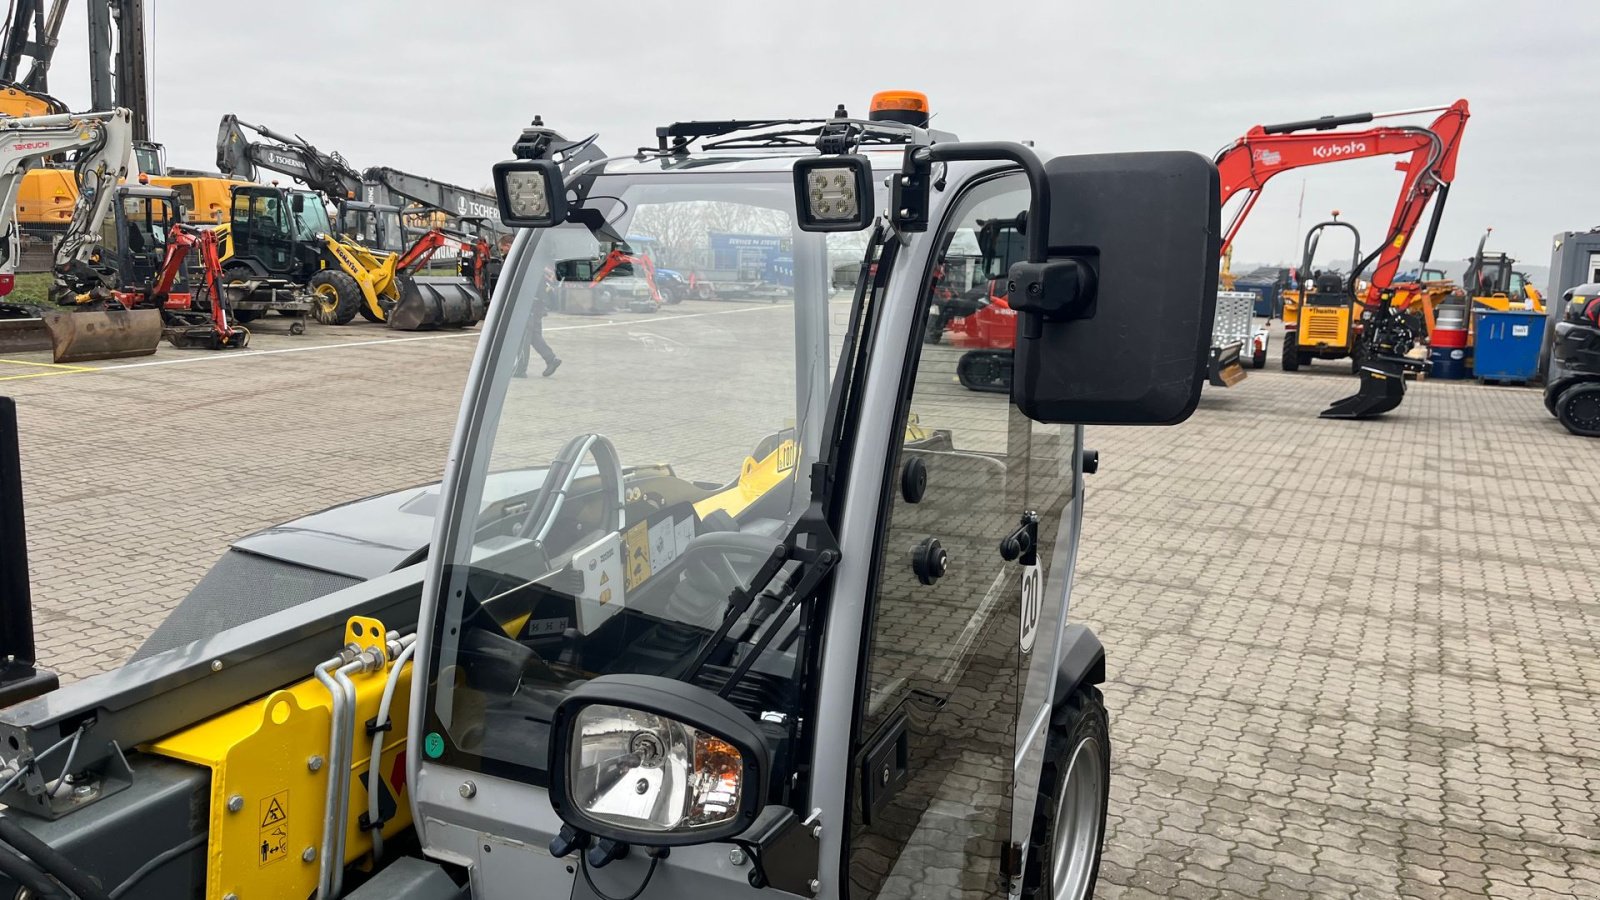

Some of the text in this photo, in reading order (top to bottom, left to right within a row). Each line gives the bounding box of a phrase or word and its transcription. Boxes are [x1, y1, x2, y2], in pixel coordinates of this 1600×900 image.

[1313, 141, 1366, 158] Kubota
[336, 247, 358, 273] KOMATSU
[1022, 569, 1038, 639] 20
